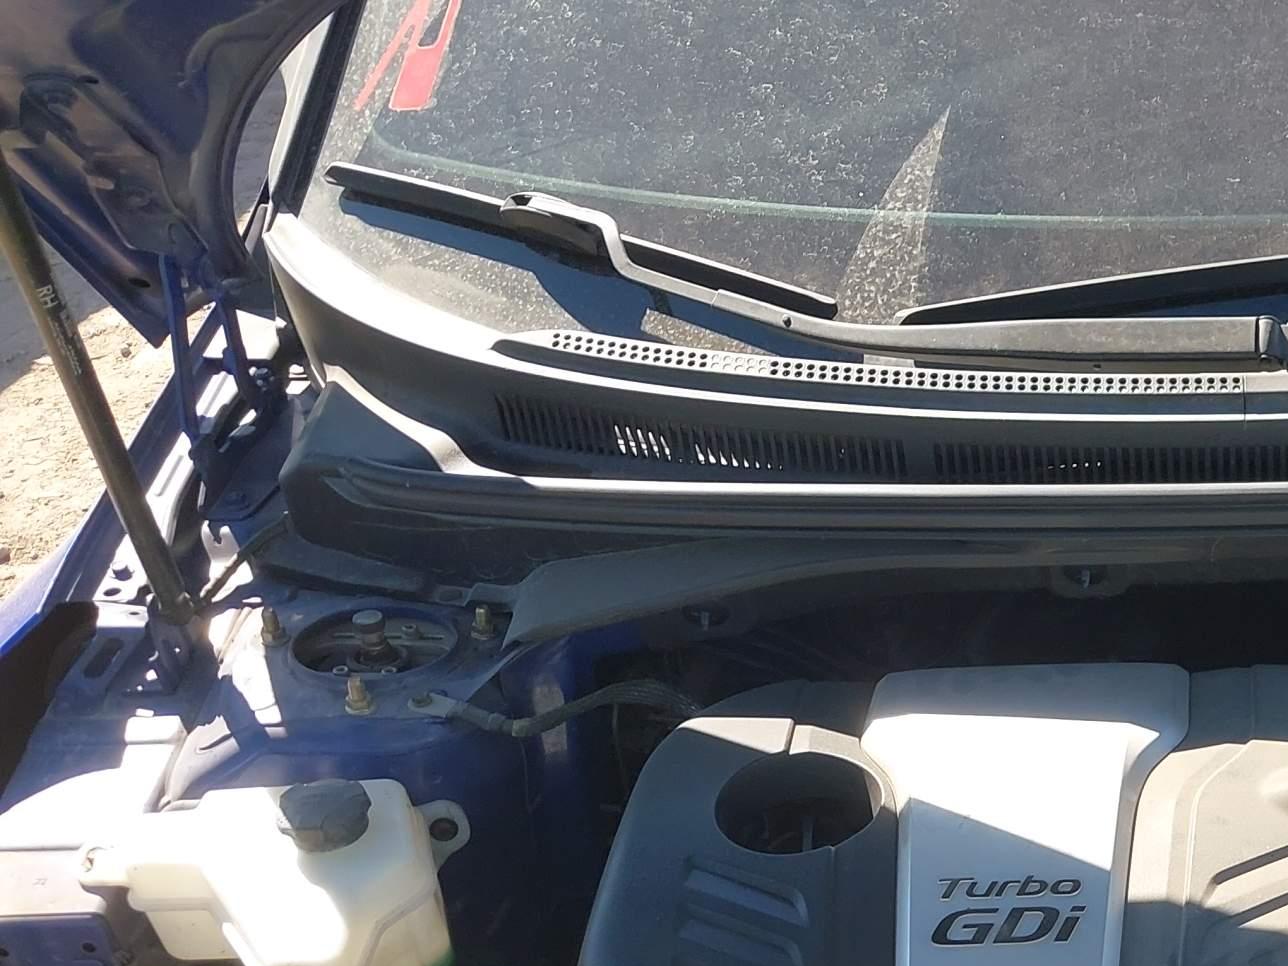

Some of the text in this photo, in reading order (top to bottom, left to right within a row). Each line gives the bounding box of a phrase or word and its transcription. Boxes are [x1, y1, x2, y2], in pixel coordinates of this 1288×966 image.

[37, 284, 59, 308] RH
[938, 875, 1082, 901] Turbo
[931, 905, 1087, 946] GDi
